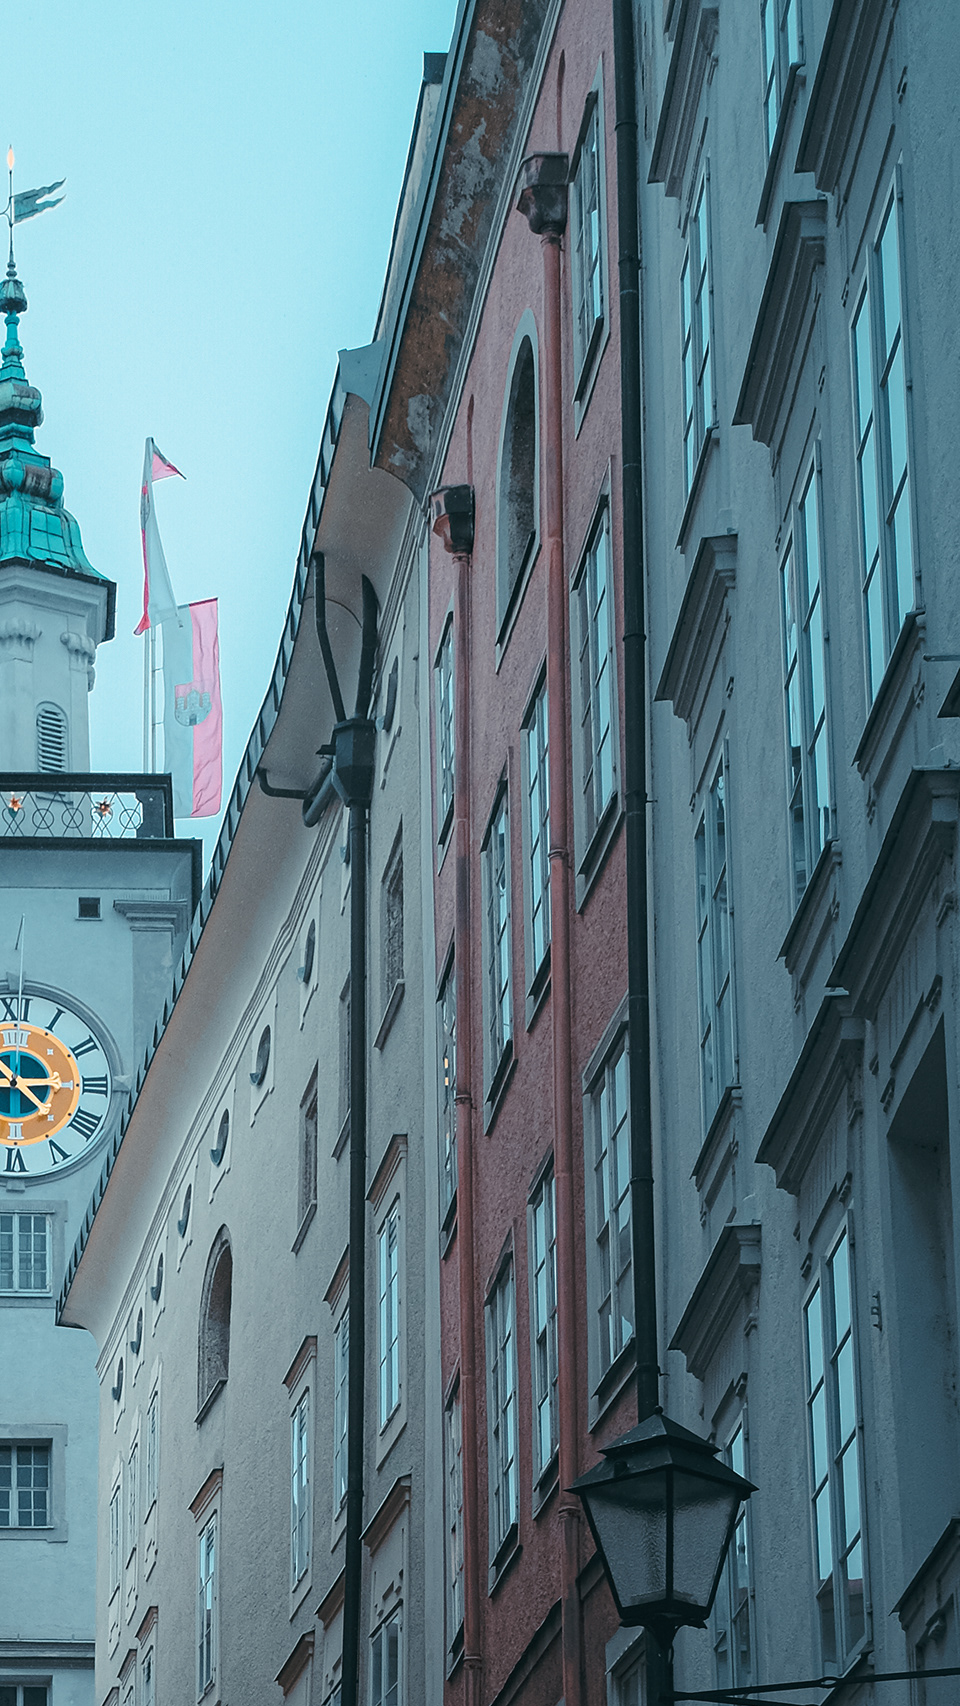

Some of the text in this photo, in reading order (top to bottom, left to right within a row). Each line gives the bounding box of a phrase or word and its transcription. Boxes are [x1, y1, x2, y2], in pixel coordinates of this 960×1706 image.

[44, 1007, 66, 1033] I
[69, 1035, 99, 1060] II
[81, 1073, 108, 1098] III
[68, 1106, 103, 1142] IIII
[3, 1147, 29, 1173] VI
[48, 1139, 72, 1167] V
